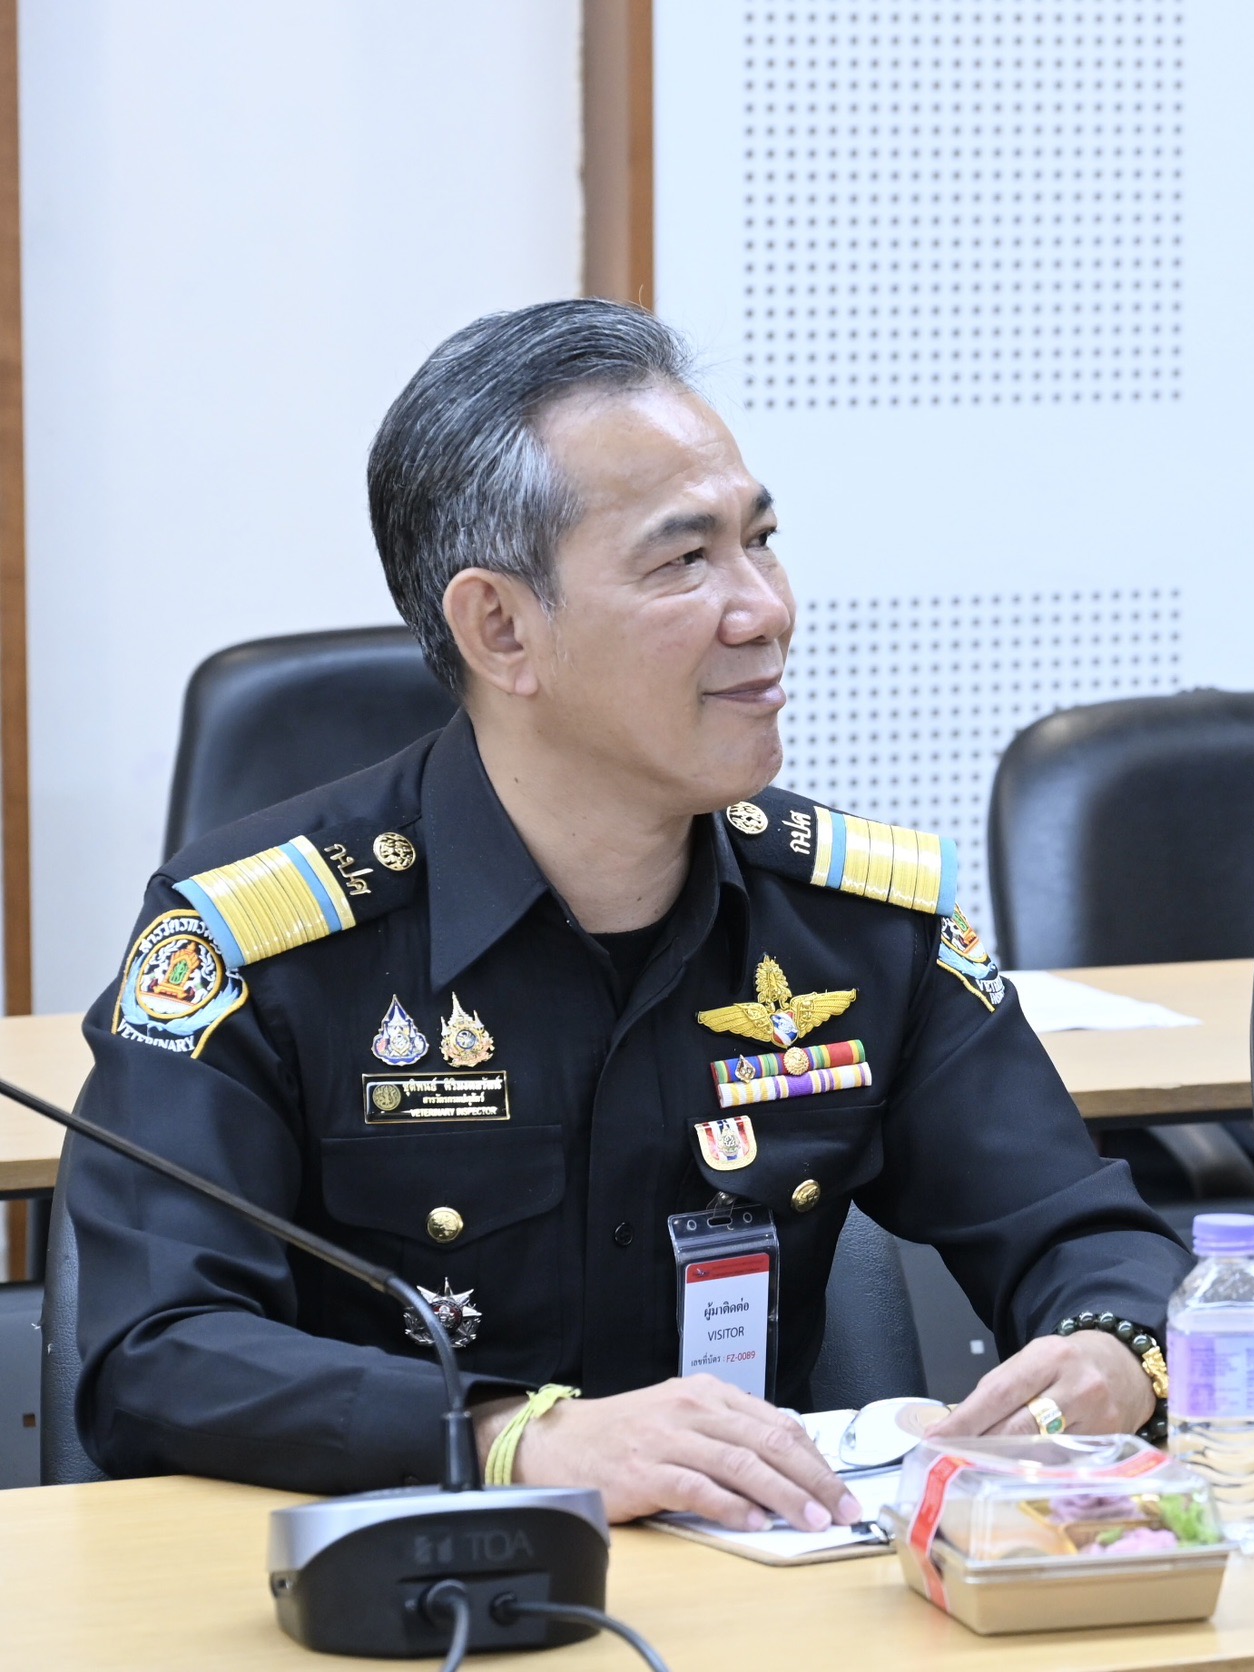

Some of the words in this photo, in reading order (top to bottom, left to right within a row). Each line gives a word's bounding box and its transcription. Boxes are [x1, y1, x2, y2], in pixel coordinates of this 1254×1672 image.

[410, 1107, 455, 1118] VETERINARY
[456, 1106, 498, 1116] INSPECTOR
[703, 1298, 750, 1320] ผู้มาติดต่อ
[707, 1326, 745, 1342] VISITOR
[690, 1352, 721, 1367] เลขที่บัตร
[726, 1350, 756, 1363] FZ-0089
[464, 1529, 535, 1560] TOA
